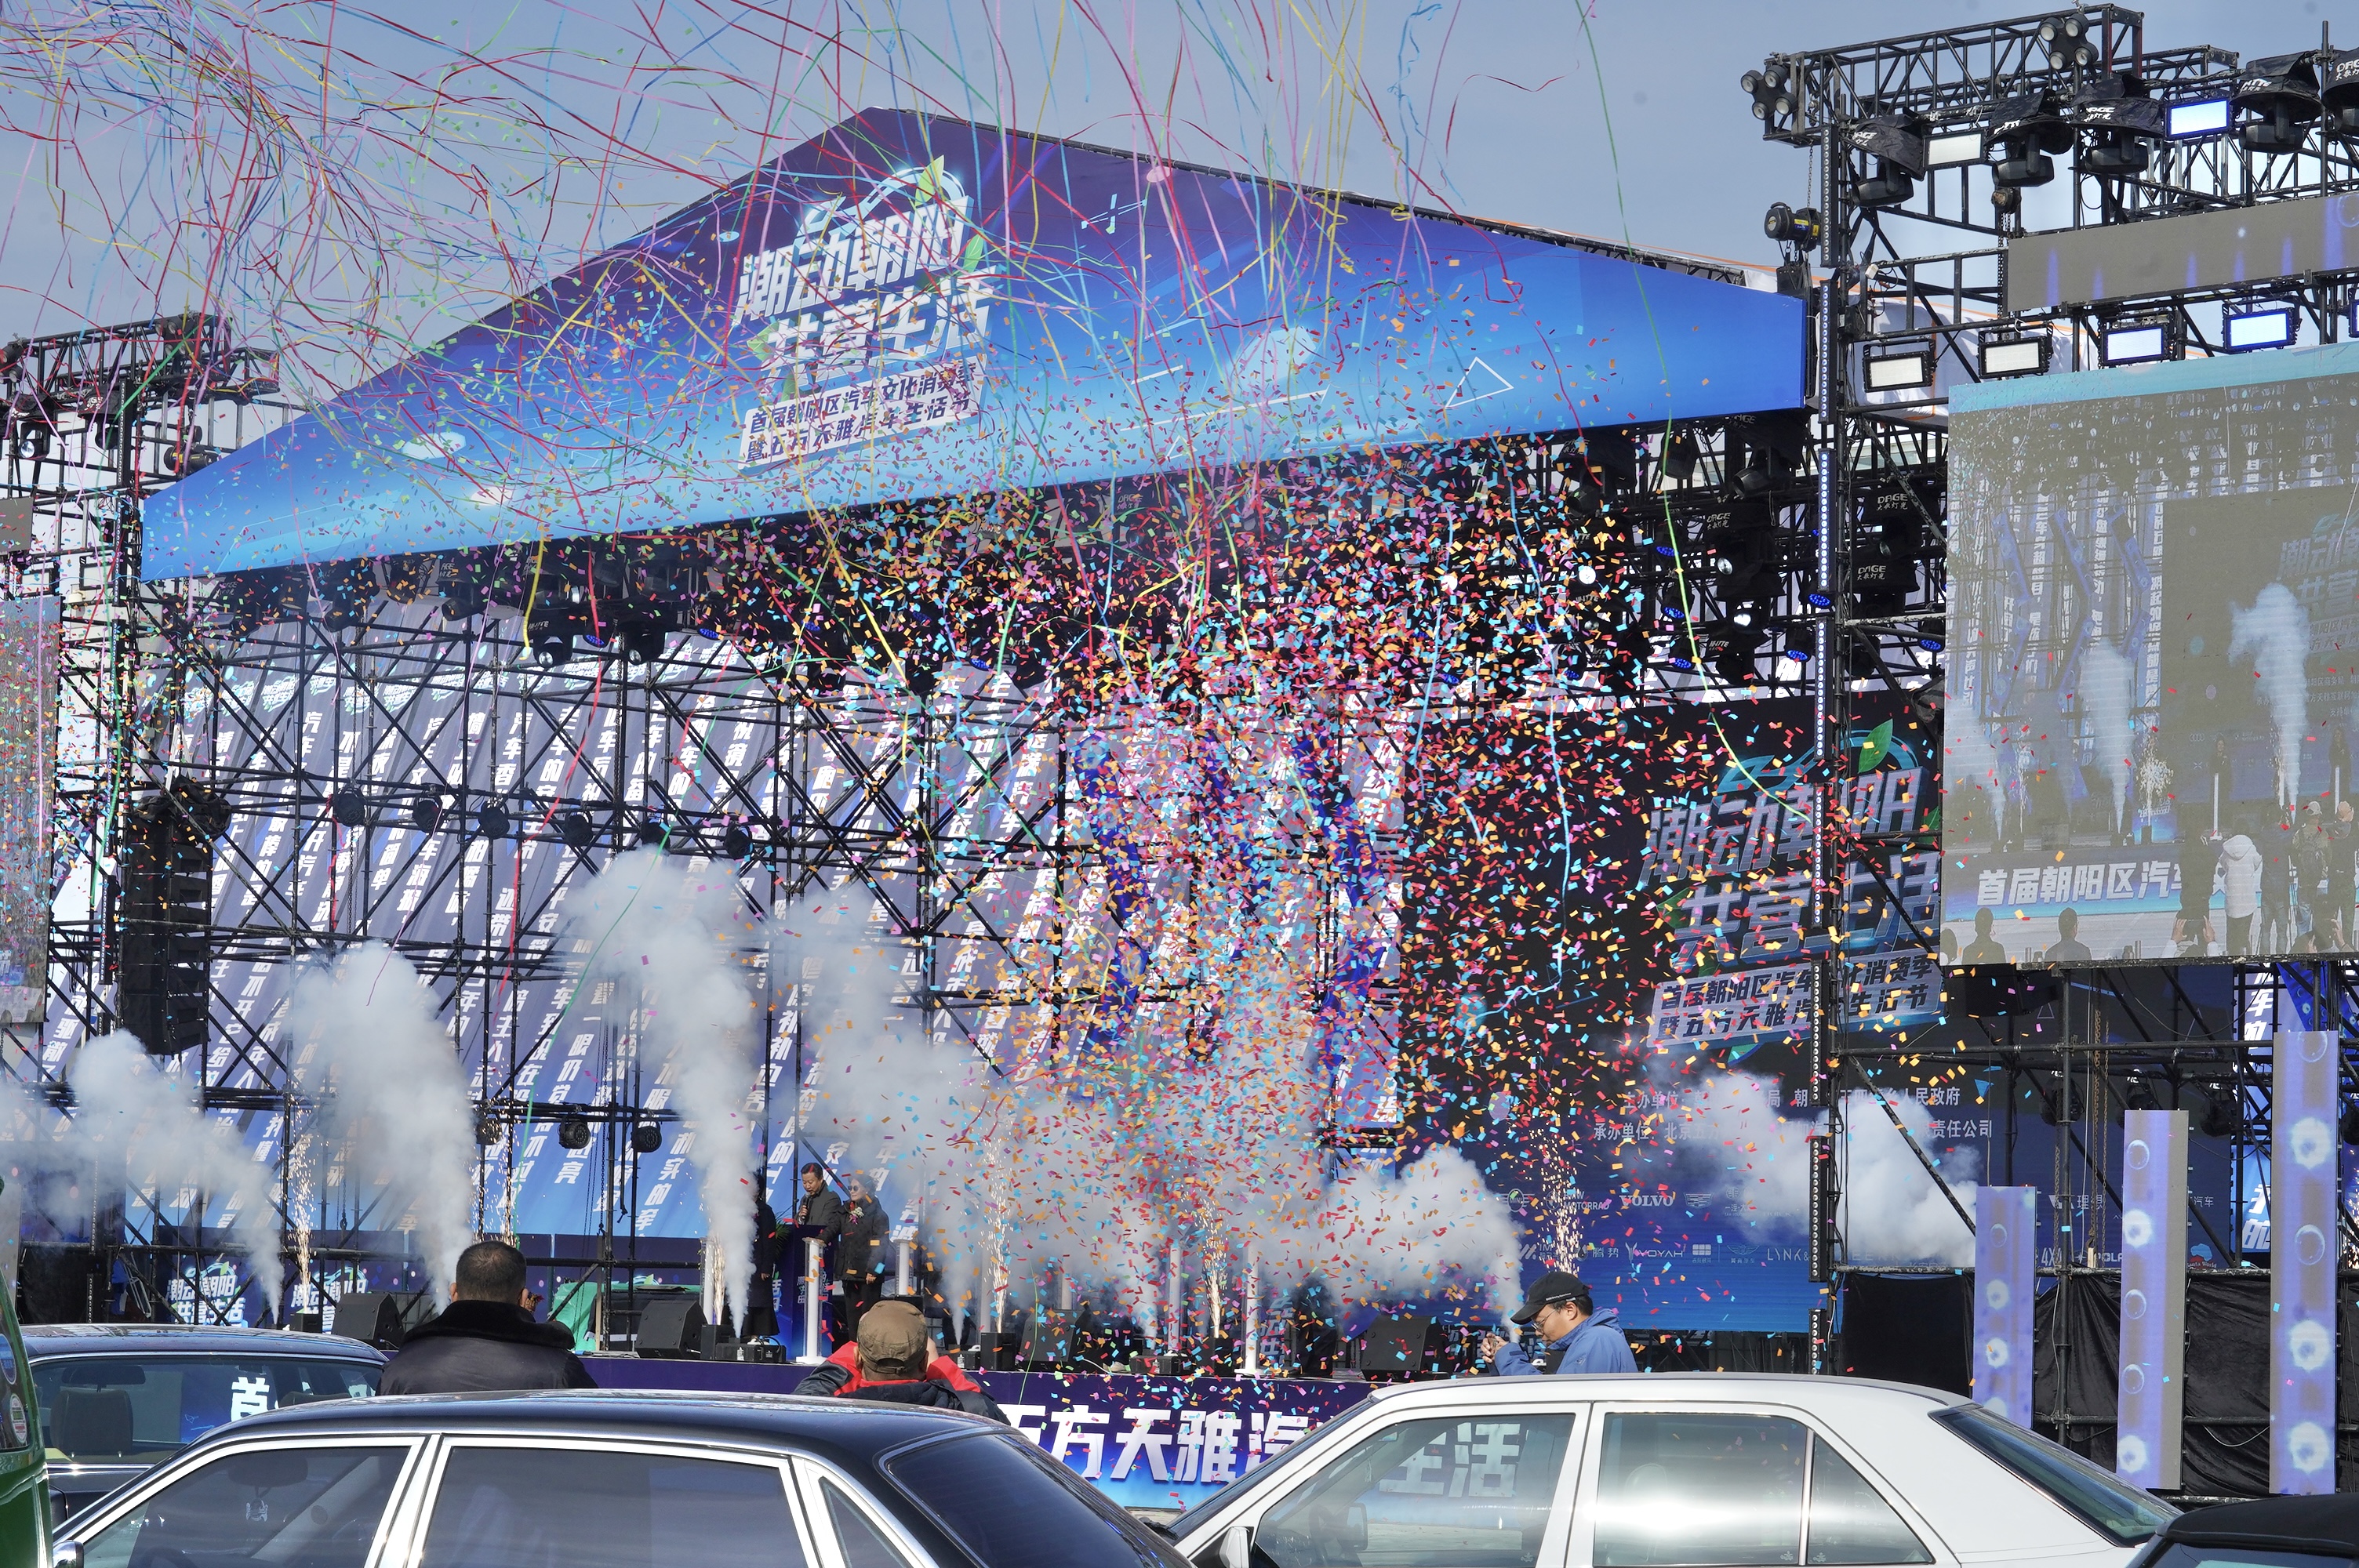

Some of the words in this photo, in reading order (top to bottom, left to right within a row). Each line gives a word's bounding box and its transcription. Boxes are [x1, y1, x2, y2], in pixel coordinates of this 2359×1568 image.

[732, 195, 972, 328] 潮动朝阳
[1661, 955, 1934, 1010] 首届朝阳区汽车化消费季
[1657, 984, 1929, 1040] 暨五方天雅汽生活节
[1619, 1194, 1674, 1207] VOLVO
[2189, 1196, 2215, 1208] 汽车
